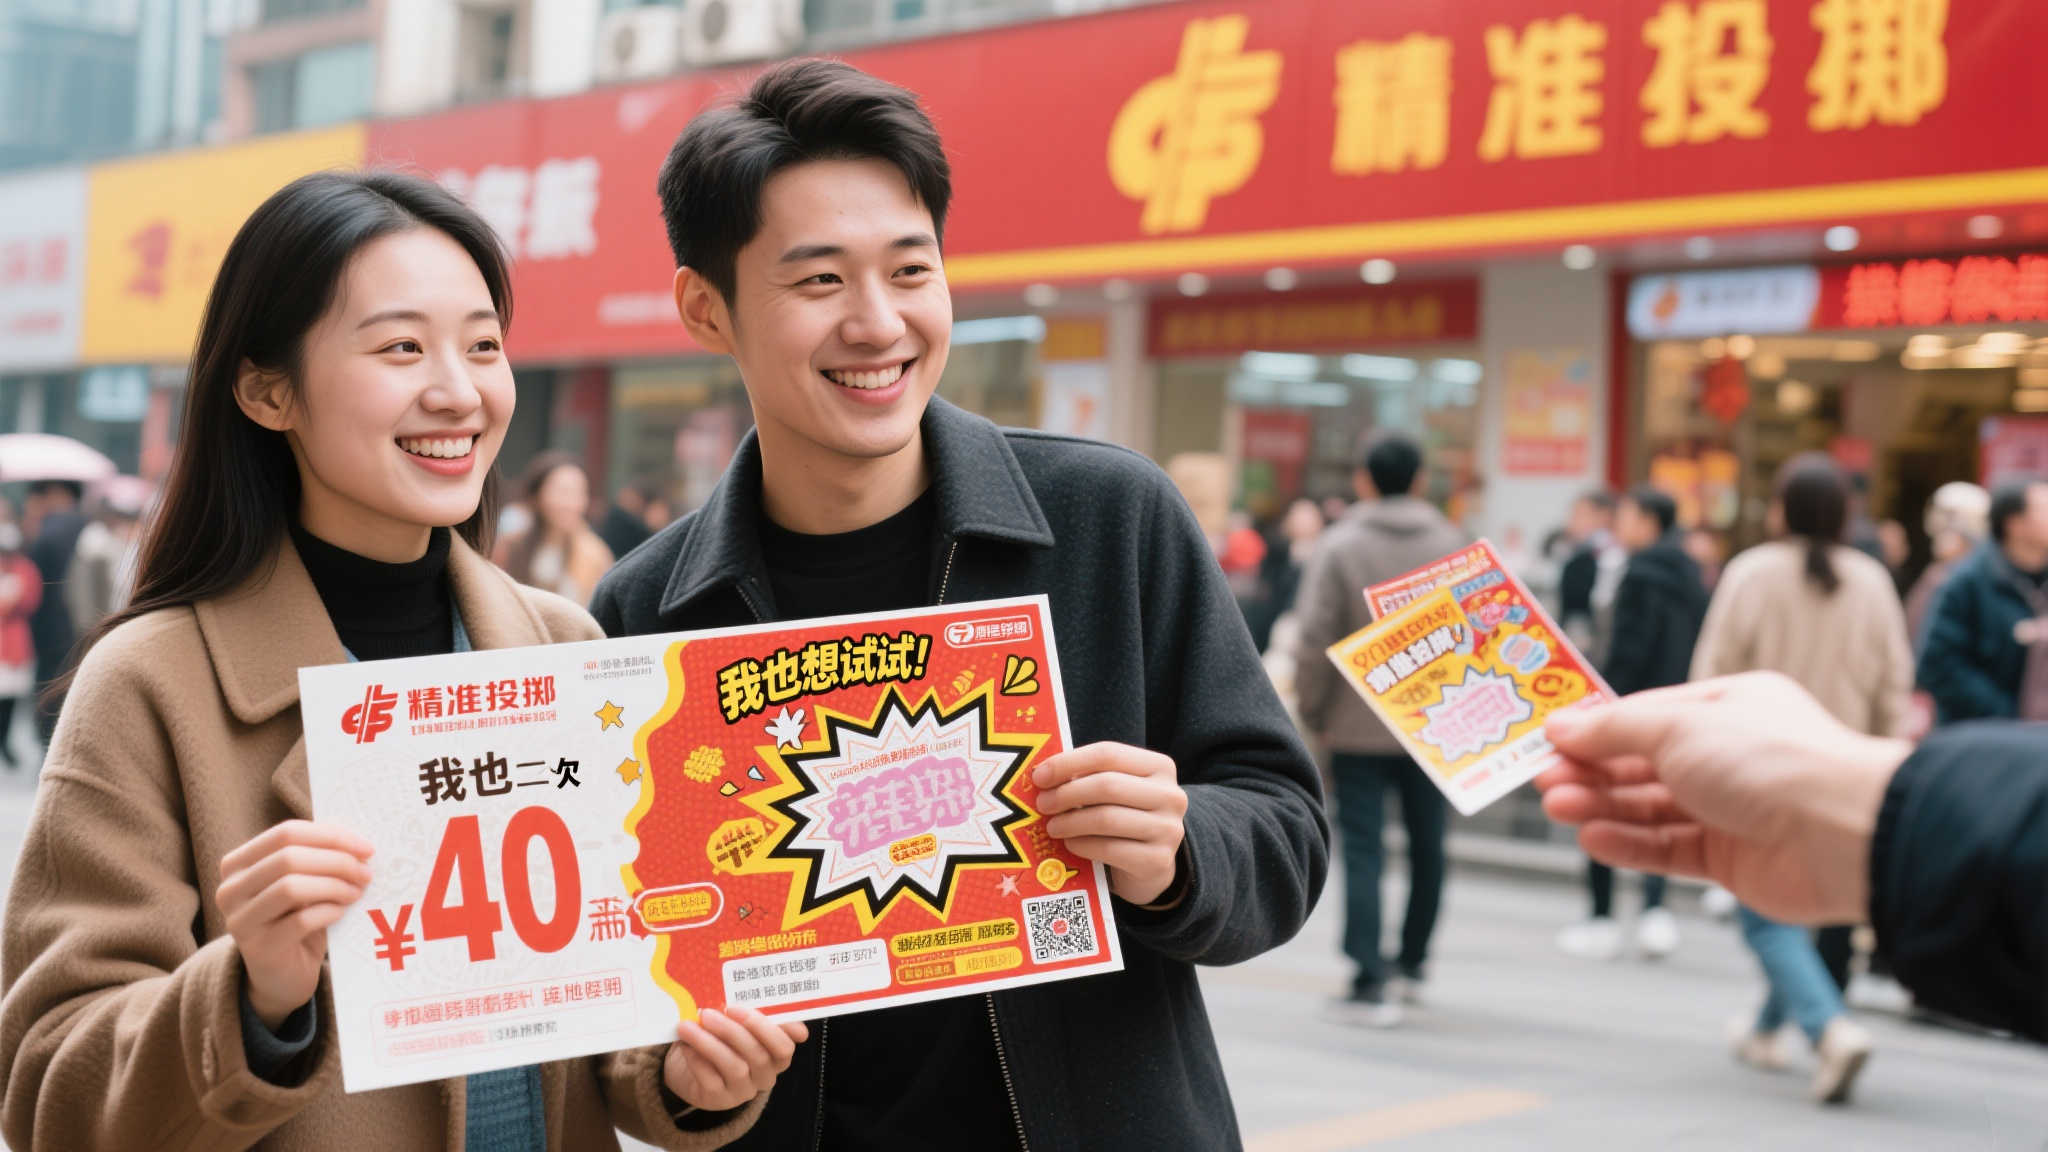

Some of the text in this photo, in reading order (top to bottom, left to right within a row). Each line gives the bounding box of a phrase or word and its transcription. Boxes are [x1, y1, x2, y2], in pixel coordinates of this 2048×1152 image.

[1331, 0, 1950, 176] 精准投掷
[408, 675, 556, 720] 精准投掷
[718, 631, 932, 723] 我也想试试!
